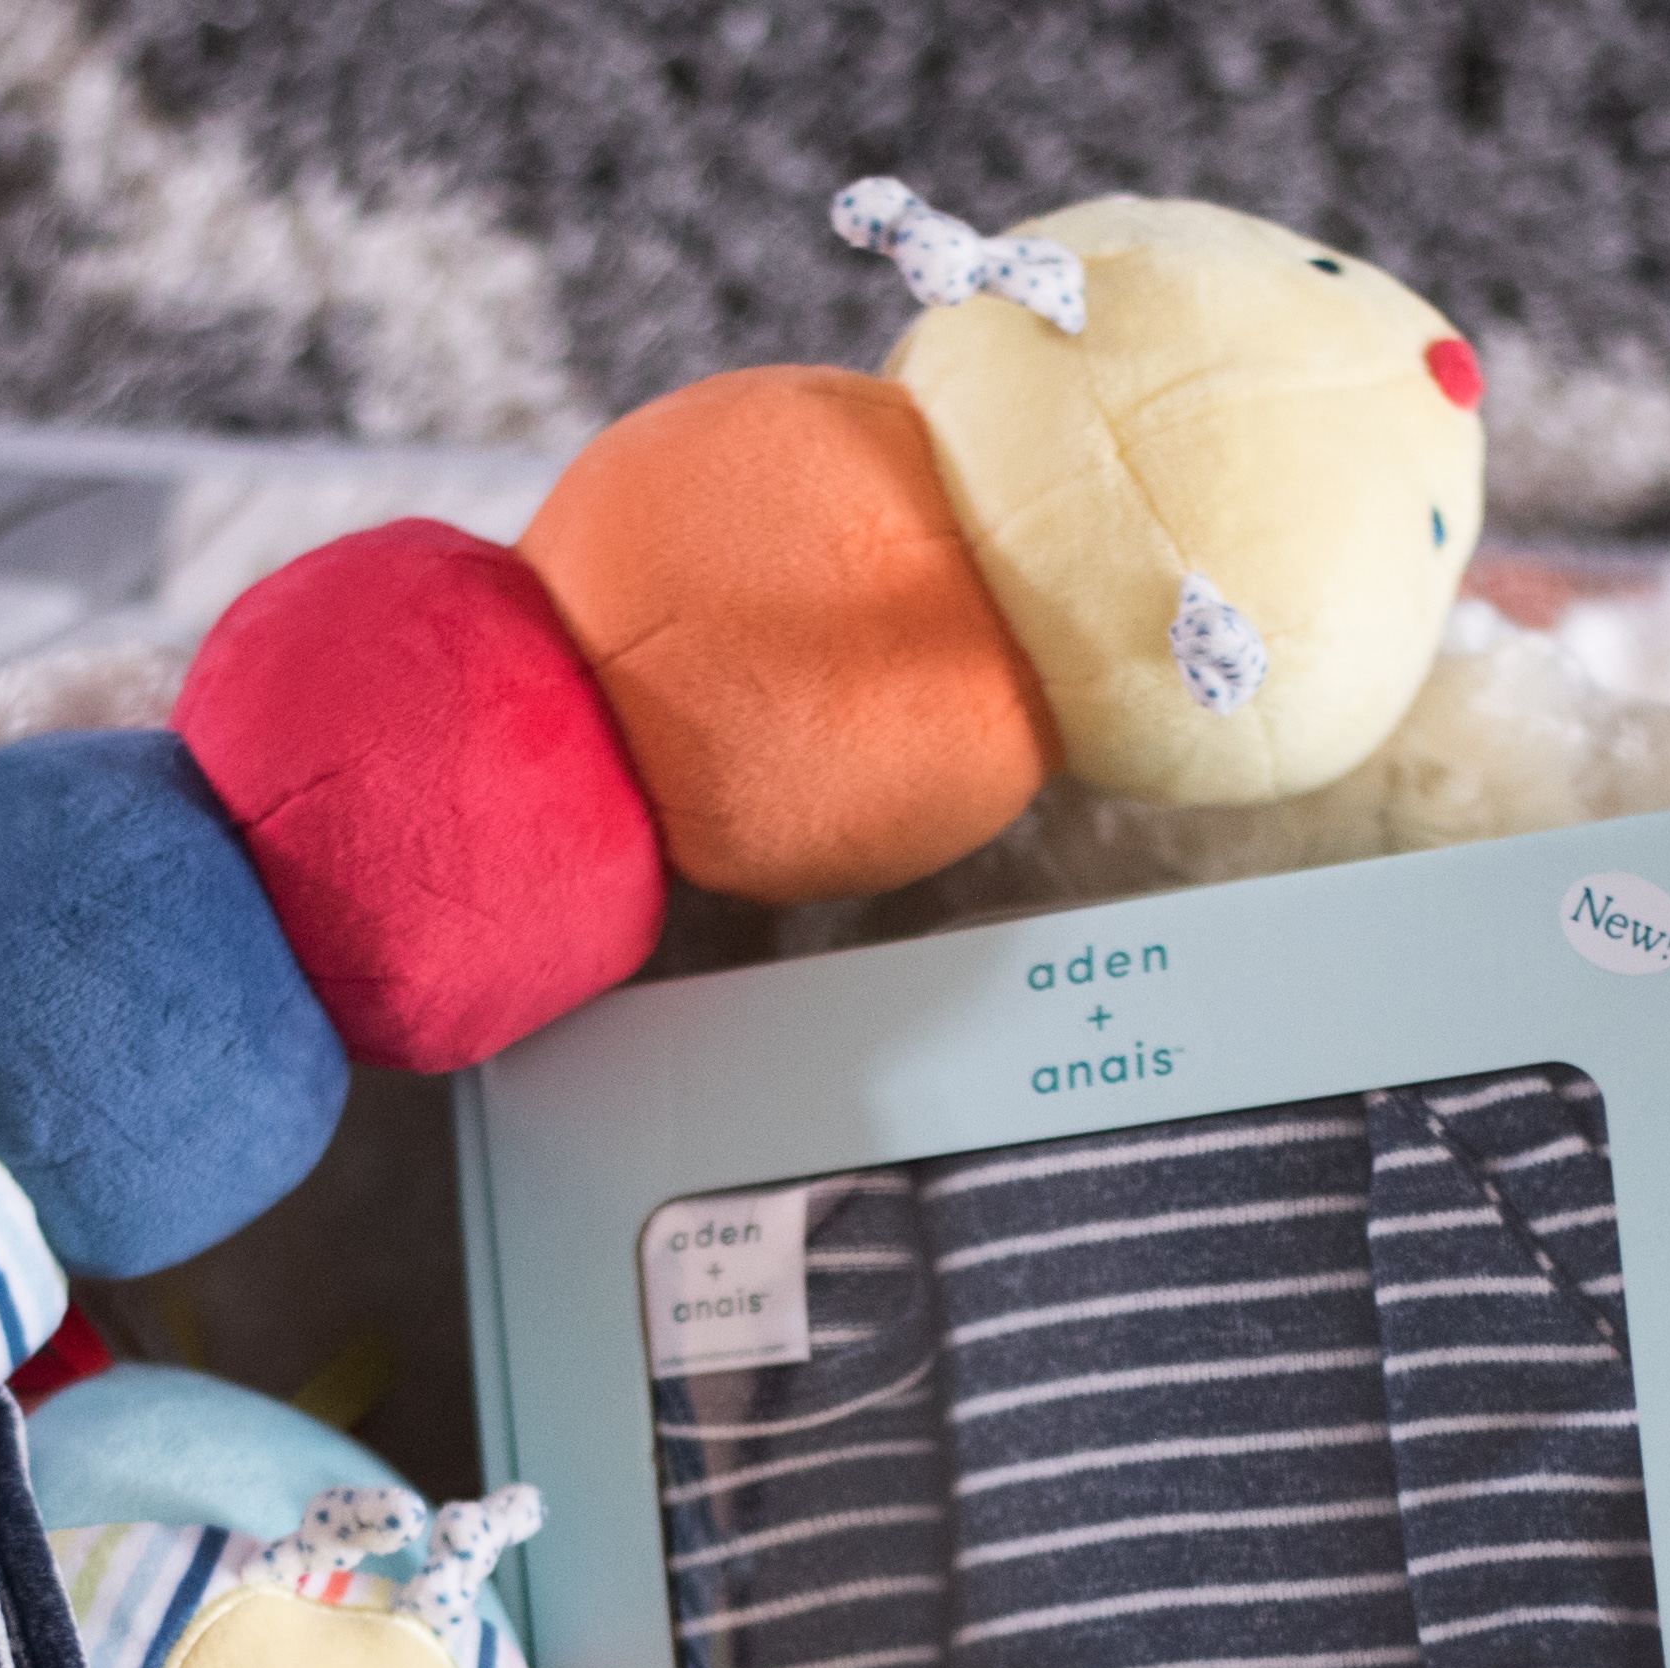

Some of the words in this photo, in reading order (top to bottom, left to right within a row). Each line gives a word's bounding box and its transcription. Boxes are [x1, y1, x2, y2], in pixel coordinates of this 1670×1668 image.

[1027, 942, 1169, 990] aden
[1086, 1004, 1113, 1031] +
[669, 1219, 762, 1251] aden
